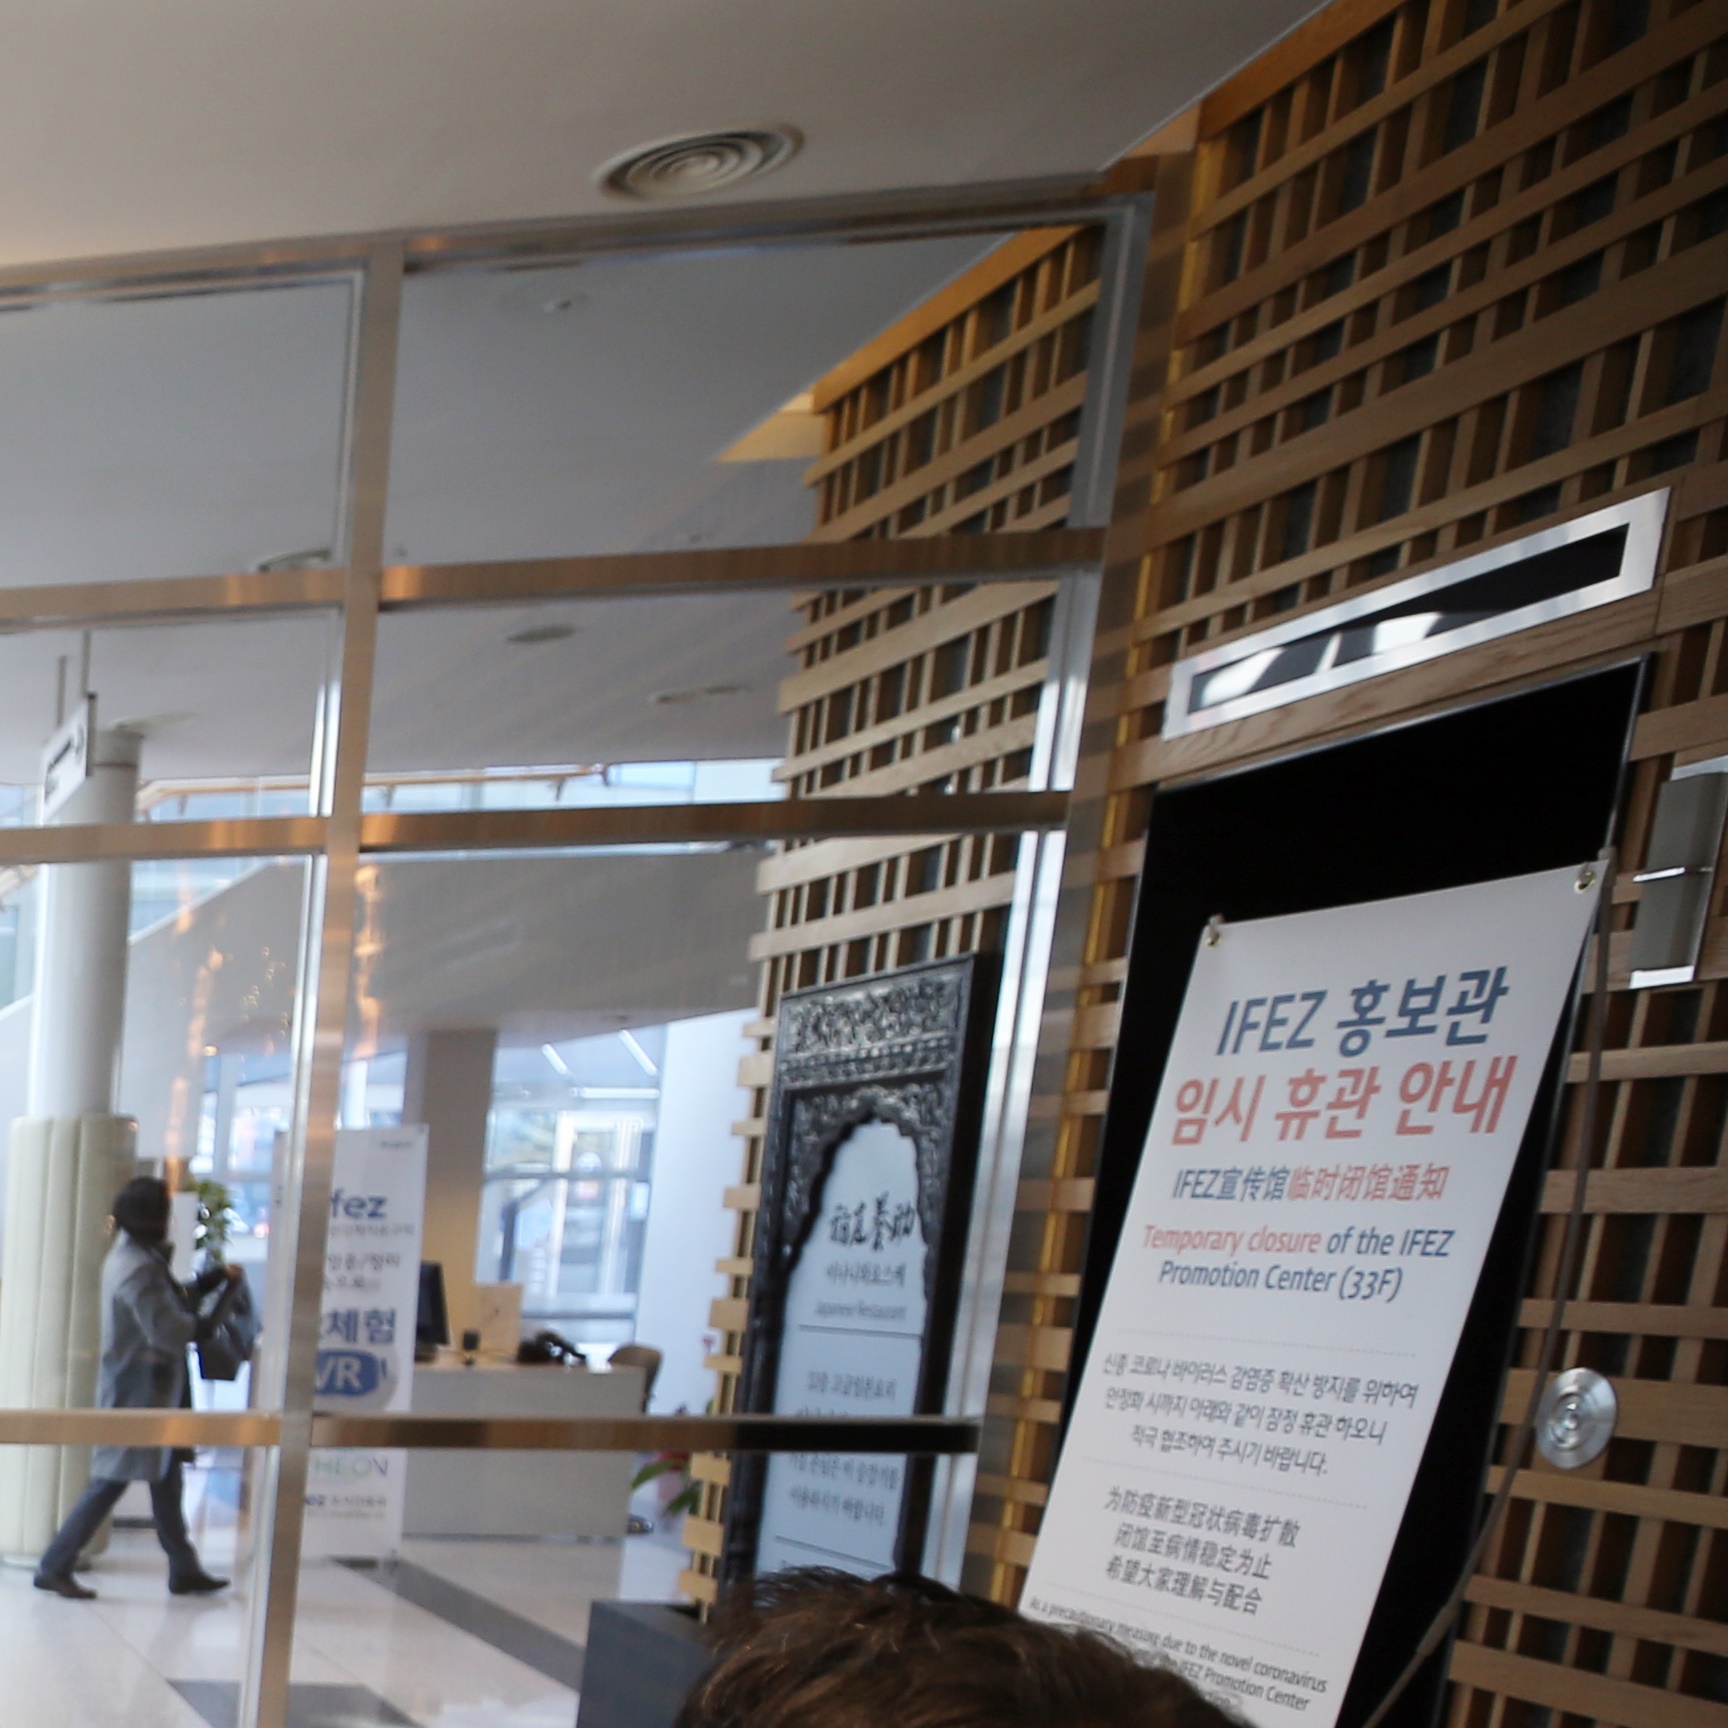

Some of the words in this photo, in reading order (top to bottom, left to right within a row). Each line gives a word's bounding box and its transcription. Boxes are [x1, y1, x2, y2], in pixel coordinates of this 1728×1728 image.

[1216, 989, 1328, 1056] IFEZ
[1335, 966, 1510, 1058] 홍보관
[1171, 1074, 1267, 1146] 임시
[1274, 1065, 1382, 1142] 휴관
[1395, 1055, 1519, 1137] 안내
[331, 1187, 388, 1218] fez
[1172, 1162, 1451, 1201] IFEZ宣传馆临时闭馆通知
[1144, 1224, 1244, 1255] Temporary
[1248, 1225, 1322, 1253] closure
[1326, 1226, 1352, 1255] of
[1356, 1227, 1394, 1256] the
[1399, 1229, 1456, 1258] IFEZ
[1158, 1259, 1259, 1289] Promotion
[1265, 1263, 1336, 1293] Center
[1338, 1264, 1403, 1303] (33F)
[320, 1307, 397, 1344] 체험
[1104, 1353, 1129, 1376] 신종
[1130, 1355, 1171, 1380] 코로나
[1173, 1360, 1227, 1385] 바이러스
[1231, 1365, 1276, 1394] 감염증
[1280, 1370, 1310, 1397] 확산
[1313, 1374, 1361, 1404] 방지를
[1362, 1377, 1420, 1409] 위하여
[1106, 1386, 1145, 1413] 안정화
[1146, 1391, 1189, 1418] 시까지
[1189, 1397, 1232, 1424] 아래와
[1234, 1402, 1266, 1429] 같이
[1267, 1406, 1298, 1435] 잠정
[1300, 1412, 1333, 1438] 휴관
[1335, 1416, 1388, 1446] 하오니
[1132, 1424, 1159, 1448] 적극
[1160, 1428, 1216, 1458] 협조하여
[1217, 1437, 1263, 1466] 주시기
[1263, 1445, 1328, 1477] 바랍니다.
[1048, 1602, 1117, 1633] precautionary
[1118, 1622, 1161, 1644] measure
[1162, 1632, 1185, 1651] due
[1185, 1640, 1198, 1655] to
[1199, 1643, 1221, 1662] the
[1221, 1650, 1254, 1673] novel
[1253, 1661, 1328, 1694] coronavirus
[1180, 1660, 1205, 1679] IFEZ
[1205, 1667, 1264, 1698] Promotion
[1266, 1686, 1312, 1712] Center
